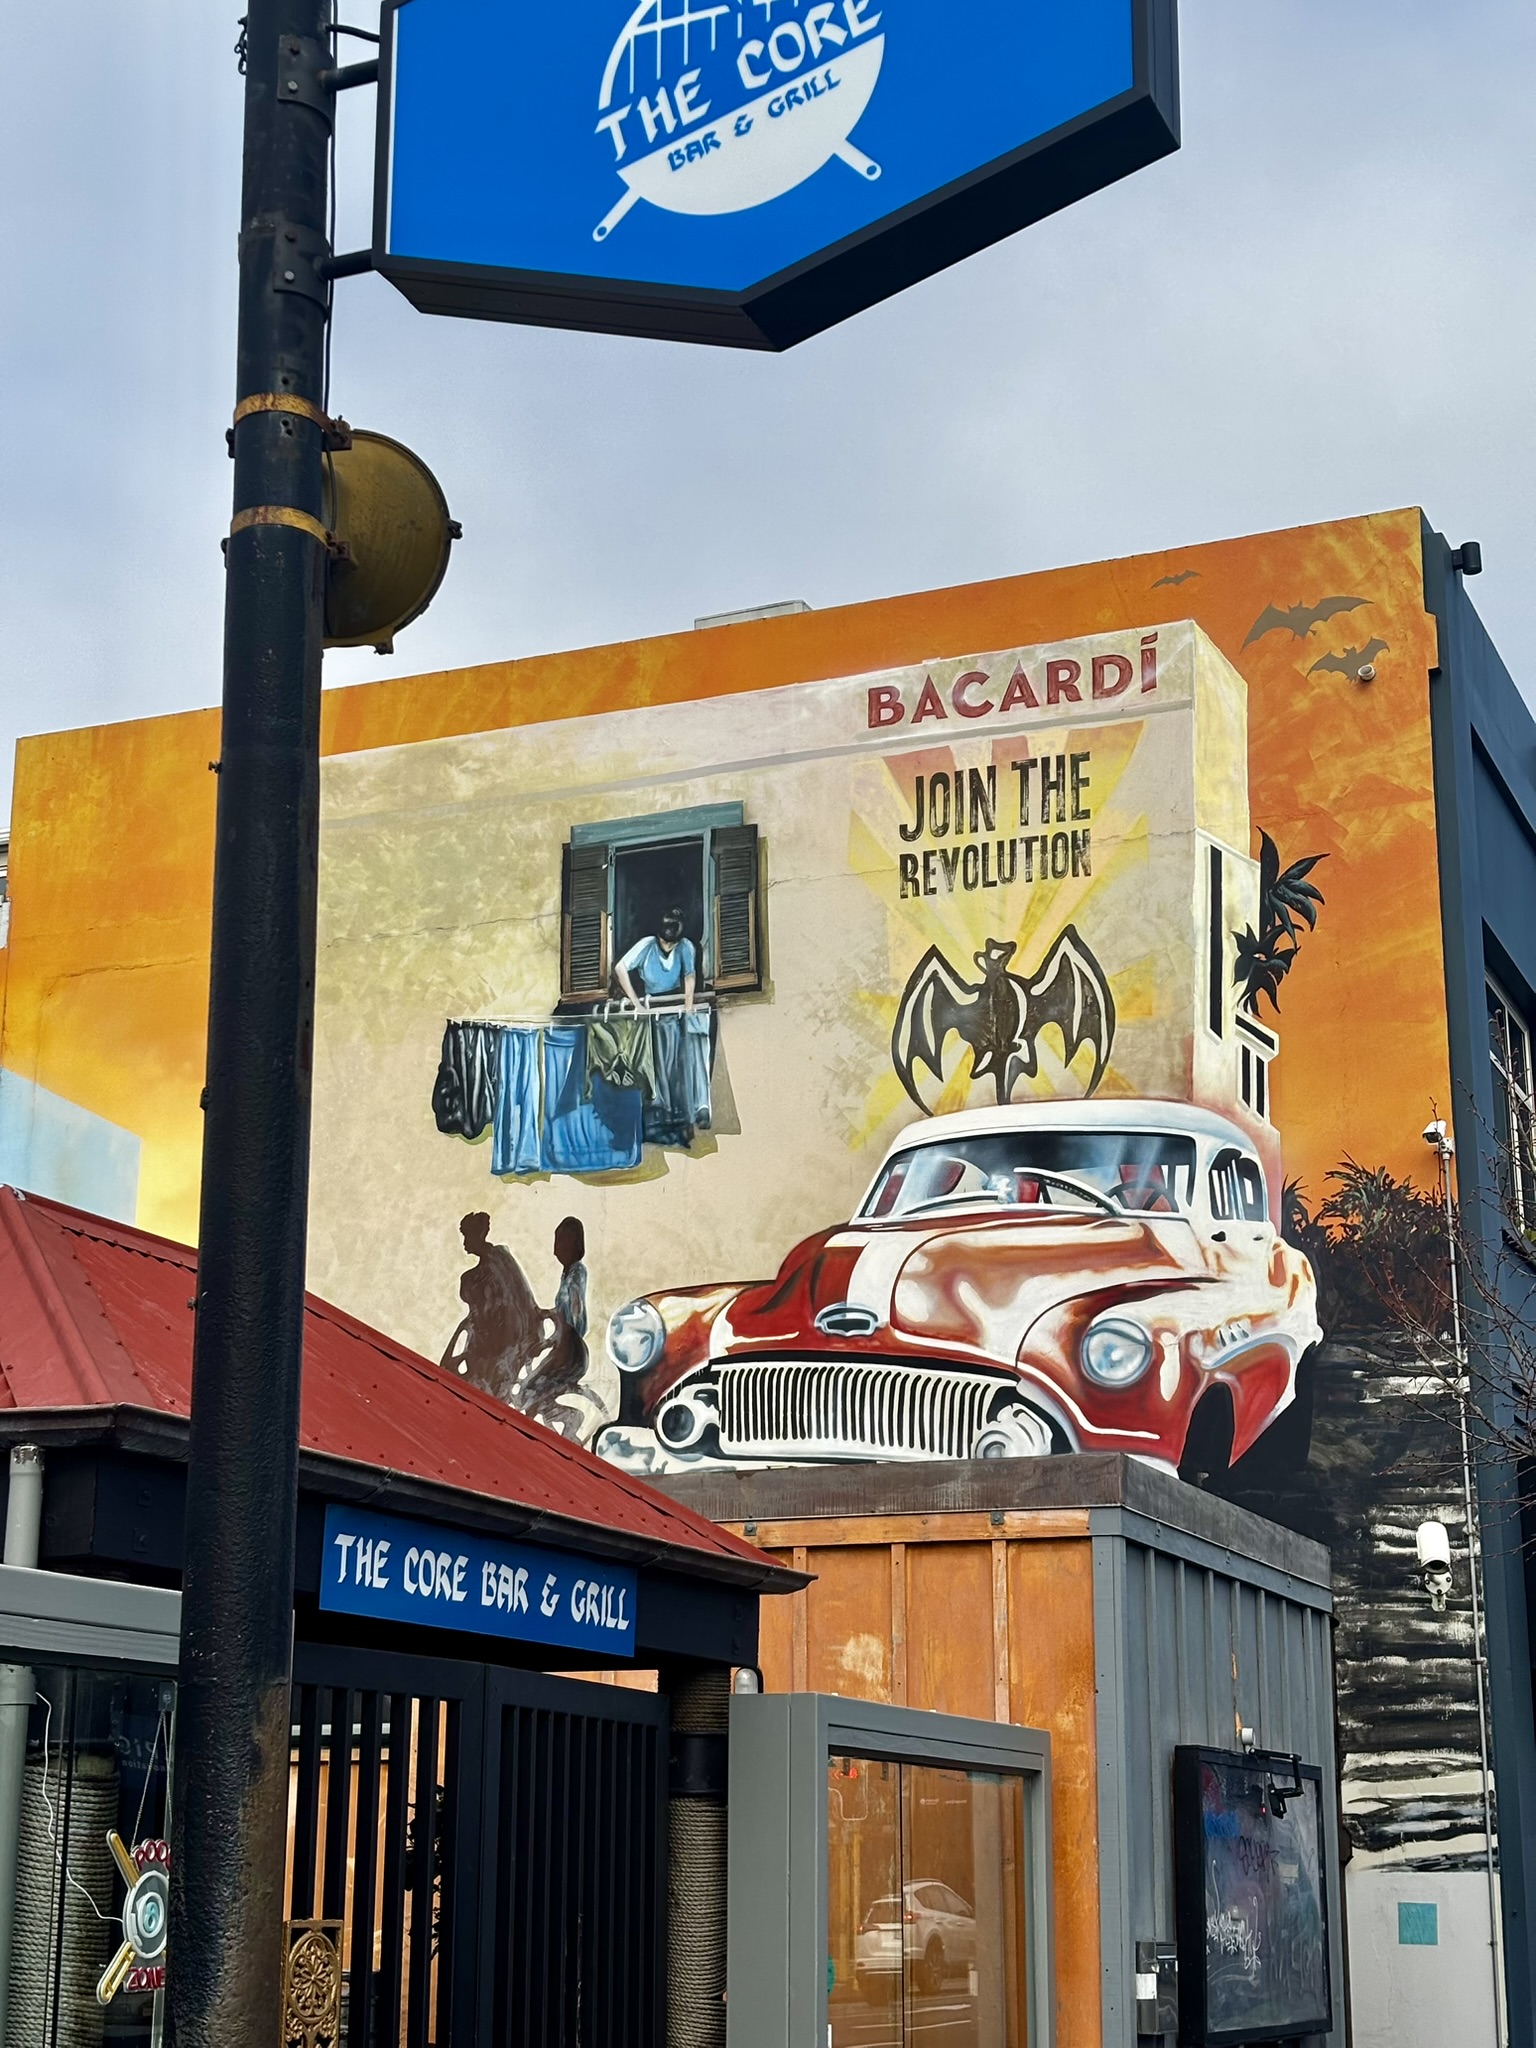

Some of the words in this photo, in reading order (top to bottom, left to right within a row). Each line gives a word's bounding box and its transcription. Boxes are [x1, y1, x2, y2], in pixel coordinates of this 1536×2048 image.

[594, 67, 712, 162] THE
[736, 0, 883, 90] CORE
[667, 131, 721, 172] BAR
[733, 114, 754, 137] &
[767, 69, 842, 118] GRILL
[867, 632, 1158, 729] BACARDÍ
[899, 764, 997, 842] JOIN
[1011, 751, 1091, 827] THE
[899, 828, 1092, 899] REVOLUTION
[334, 1533, 391, 1589] THE
[403, 1547, 469, 1602] CORE
[481, 1561, 529, 1614] BAR
[540, 1573, 560, 1617] &
[570, 1579, 630, 1630] GRILL
